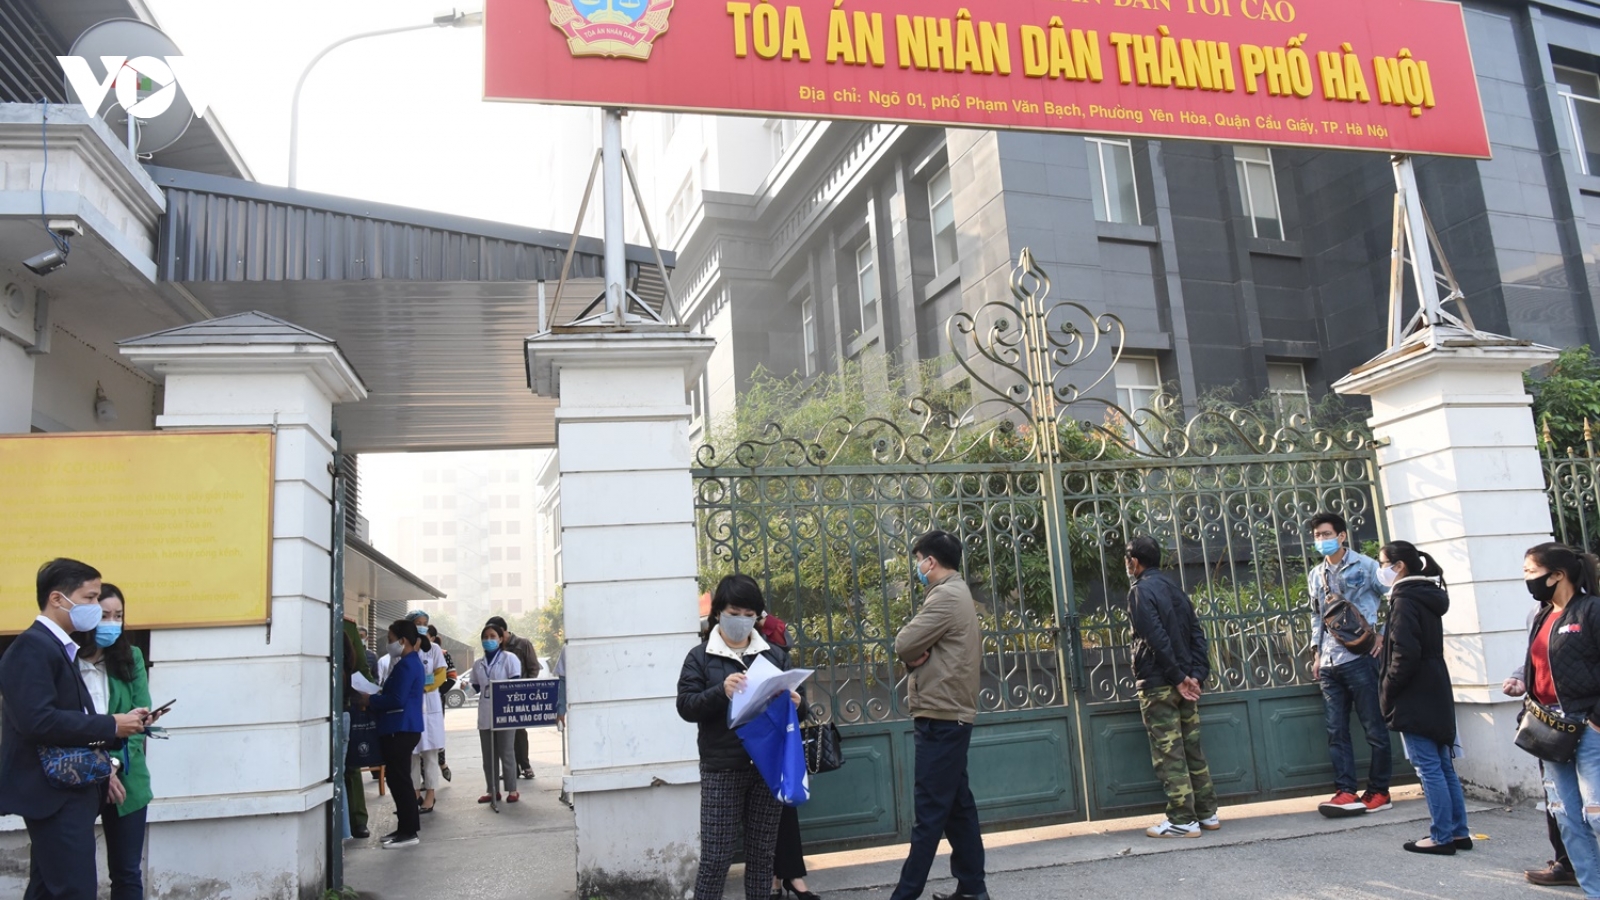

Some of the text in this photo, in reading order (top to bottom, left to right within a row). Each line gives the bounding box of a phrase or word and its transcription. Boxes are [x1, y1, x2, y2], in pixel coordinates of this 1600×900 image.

[1240, 0, 1296, 23] CAO
[826, 0, 886, 67] ÁN
[895, 7, 1012, 76] NHÂN
[1019, 15, 1104, 83] DÂN
[1108, 24, 1237, 93] THÀNH
[1238, 32, 1314, 98] PHỐ
[1316, 41, 1371, 103] HÀ
[1372, 46, 1436, 118] NỘI
[799, 85, 826, 103] Địa
[868, 90, 901, 108] Ngõ
[906, 92, 926, 109] 01,
[931, 93, 961, 110] phố
[965, 96, 1008, 114] Phạm
[1012, 99, 1039, 114] Văn
[1044, 101, 1086, 119] Bạch,
[1089, 104, 1144, 124] Phường
[1149, 108, 1174, 123] Yên
[1179, 111, 1212, 127] Hòa,
[1215, 113, 1251, 131] Quận
[1255, 115, 1282, 131] Cầu
[1346, 122, 1363, 137] Hà
[507, 689, 548, 702] YÊU CẦU
[545, 703, 552, 711] XE
[496, 716, 508, 724] KHI
[519, 713, 532, 723] VÀO
